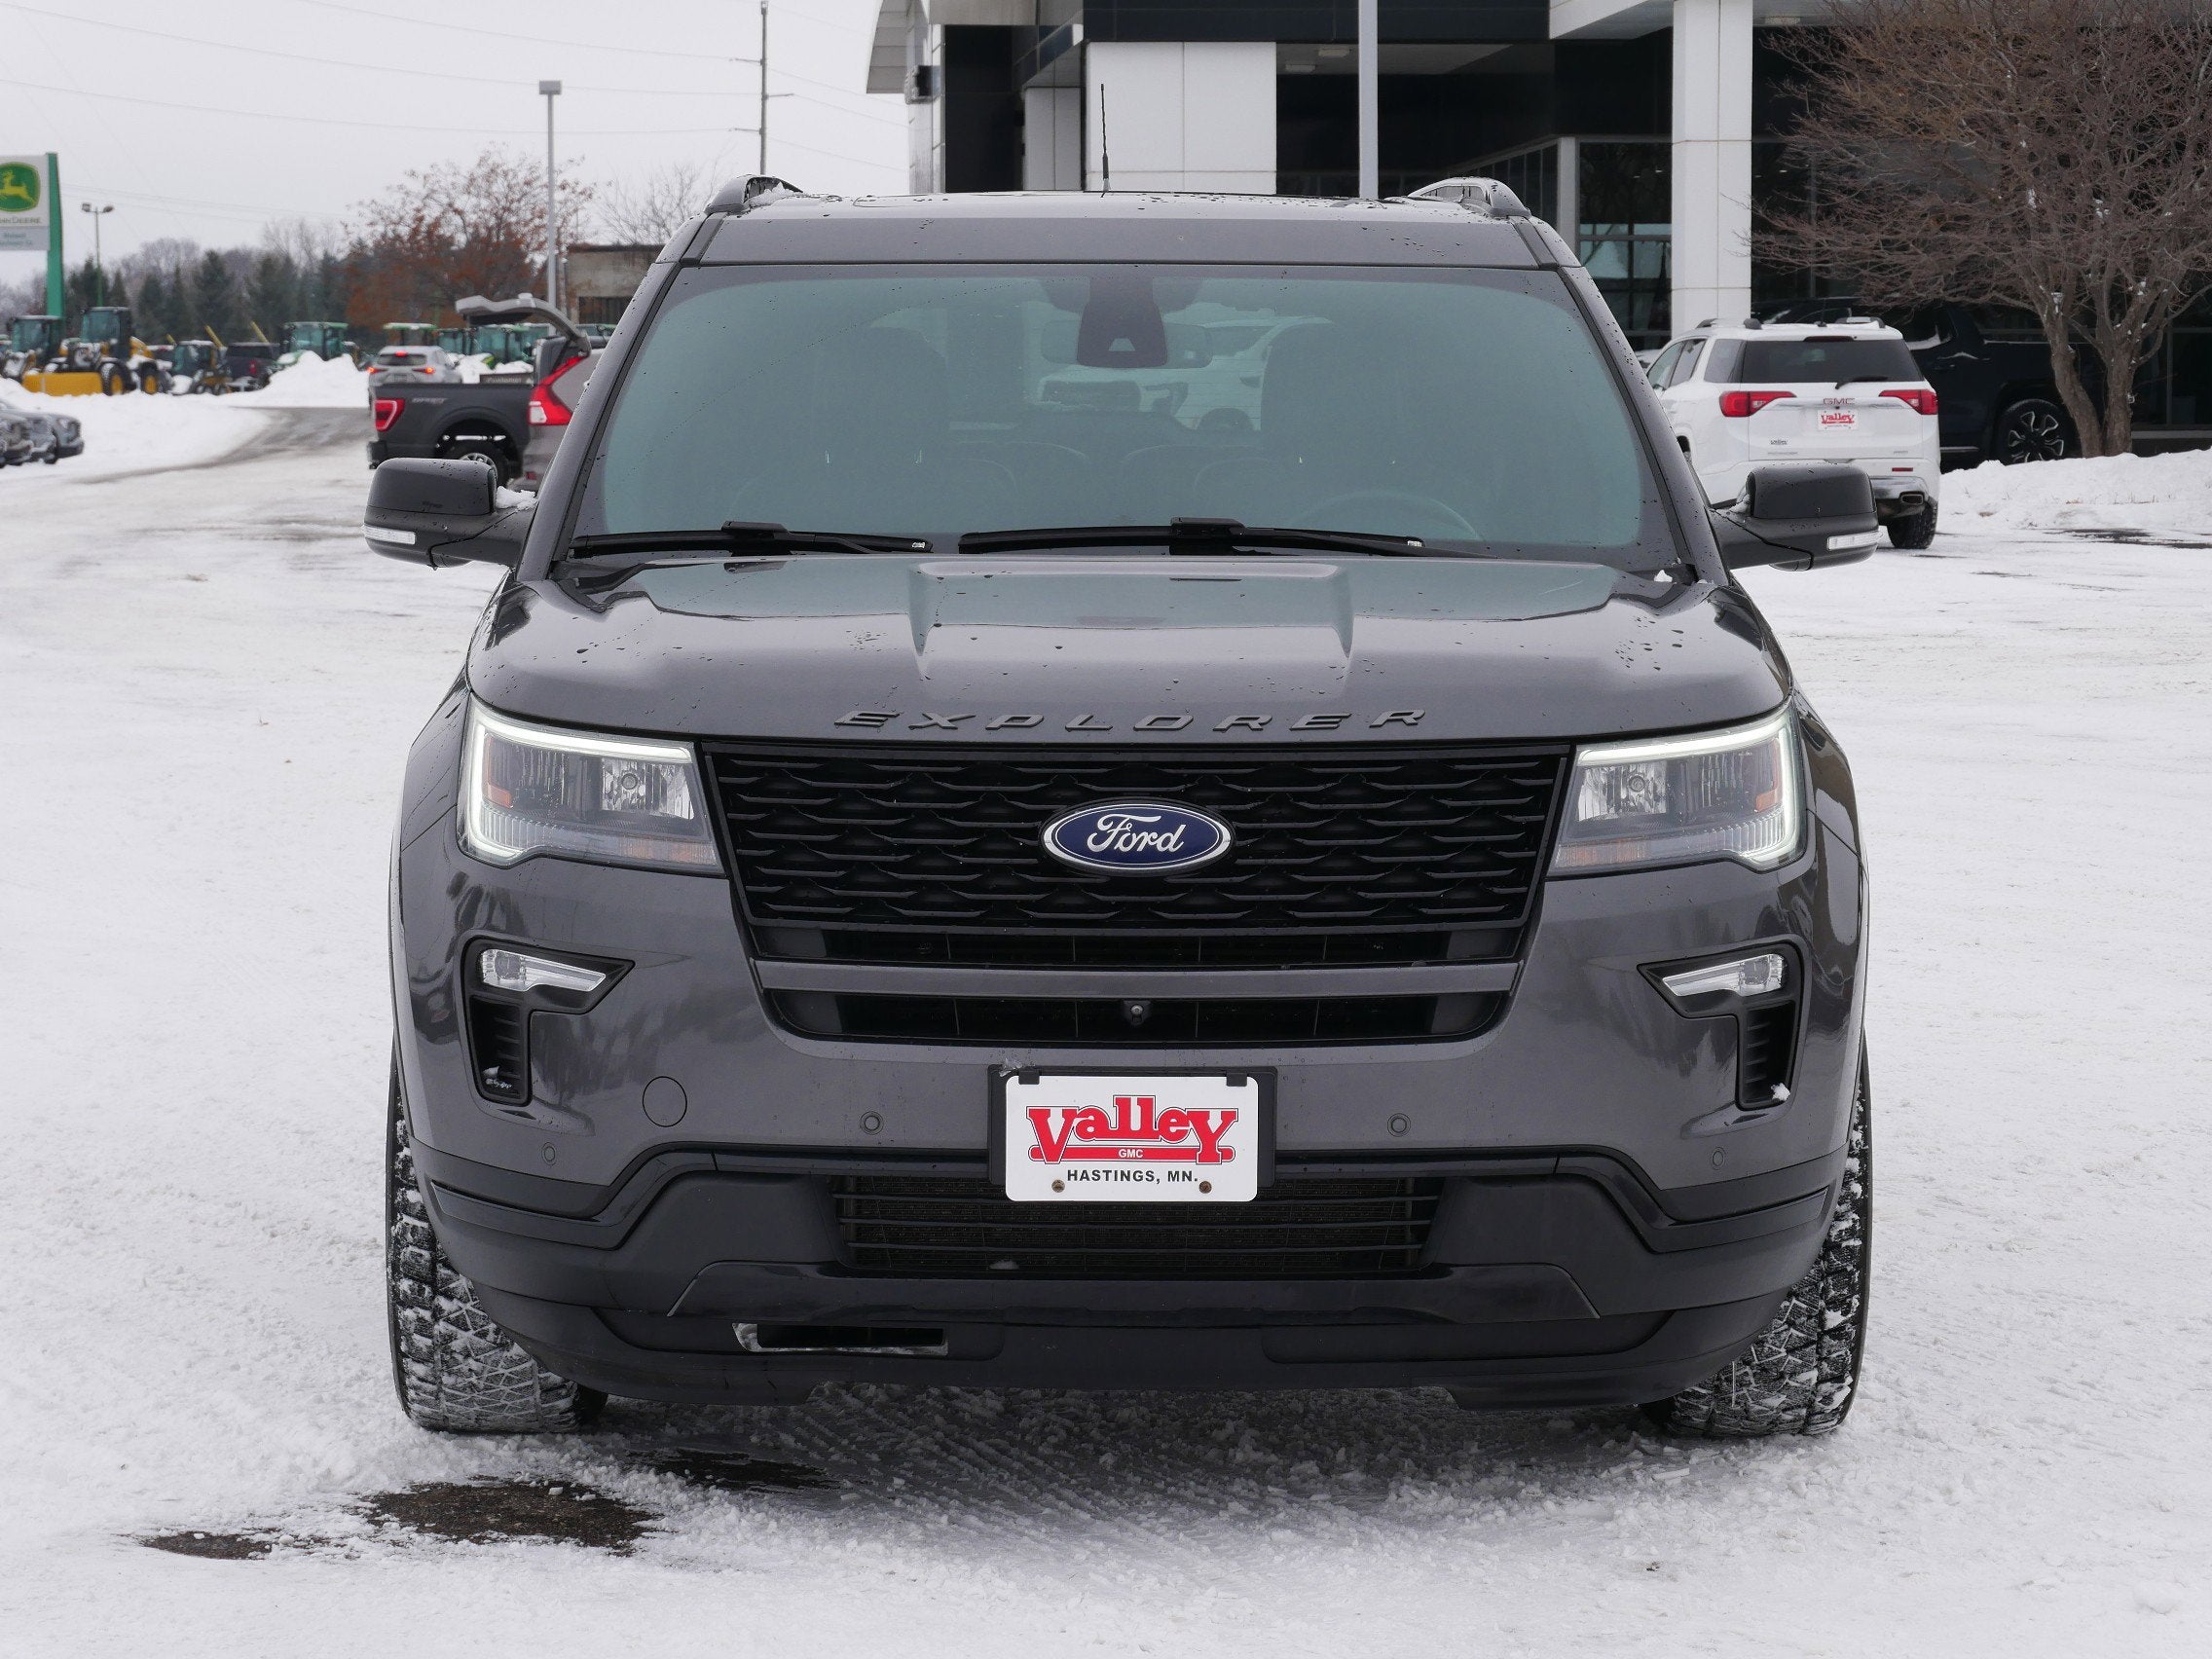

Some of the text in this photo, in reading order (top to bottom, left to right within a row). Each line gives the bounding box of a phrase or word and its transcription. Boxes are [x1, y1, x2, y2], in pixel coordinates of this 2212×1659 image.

[833, 708, 1425, 733] EXPLORER
[1087, 812, 1186, 856] Ford
[1119, 1148, 1144, 1159] GMC
[1067, 1169, 1198, 1185] HASTINGS, MN.
